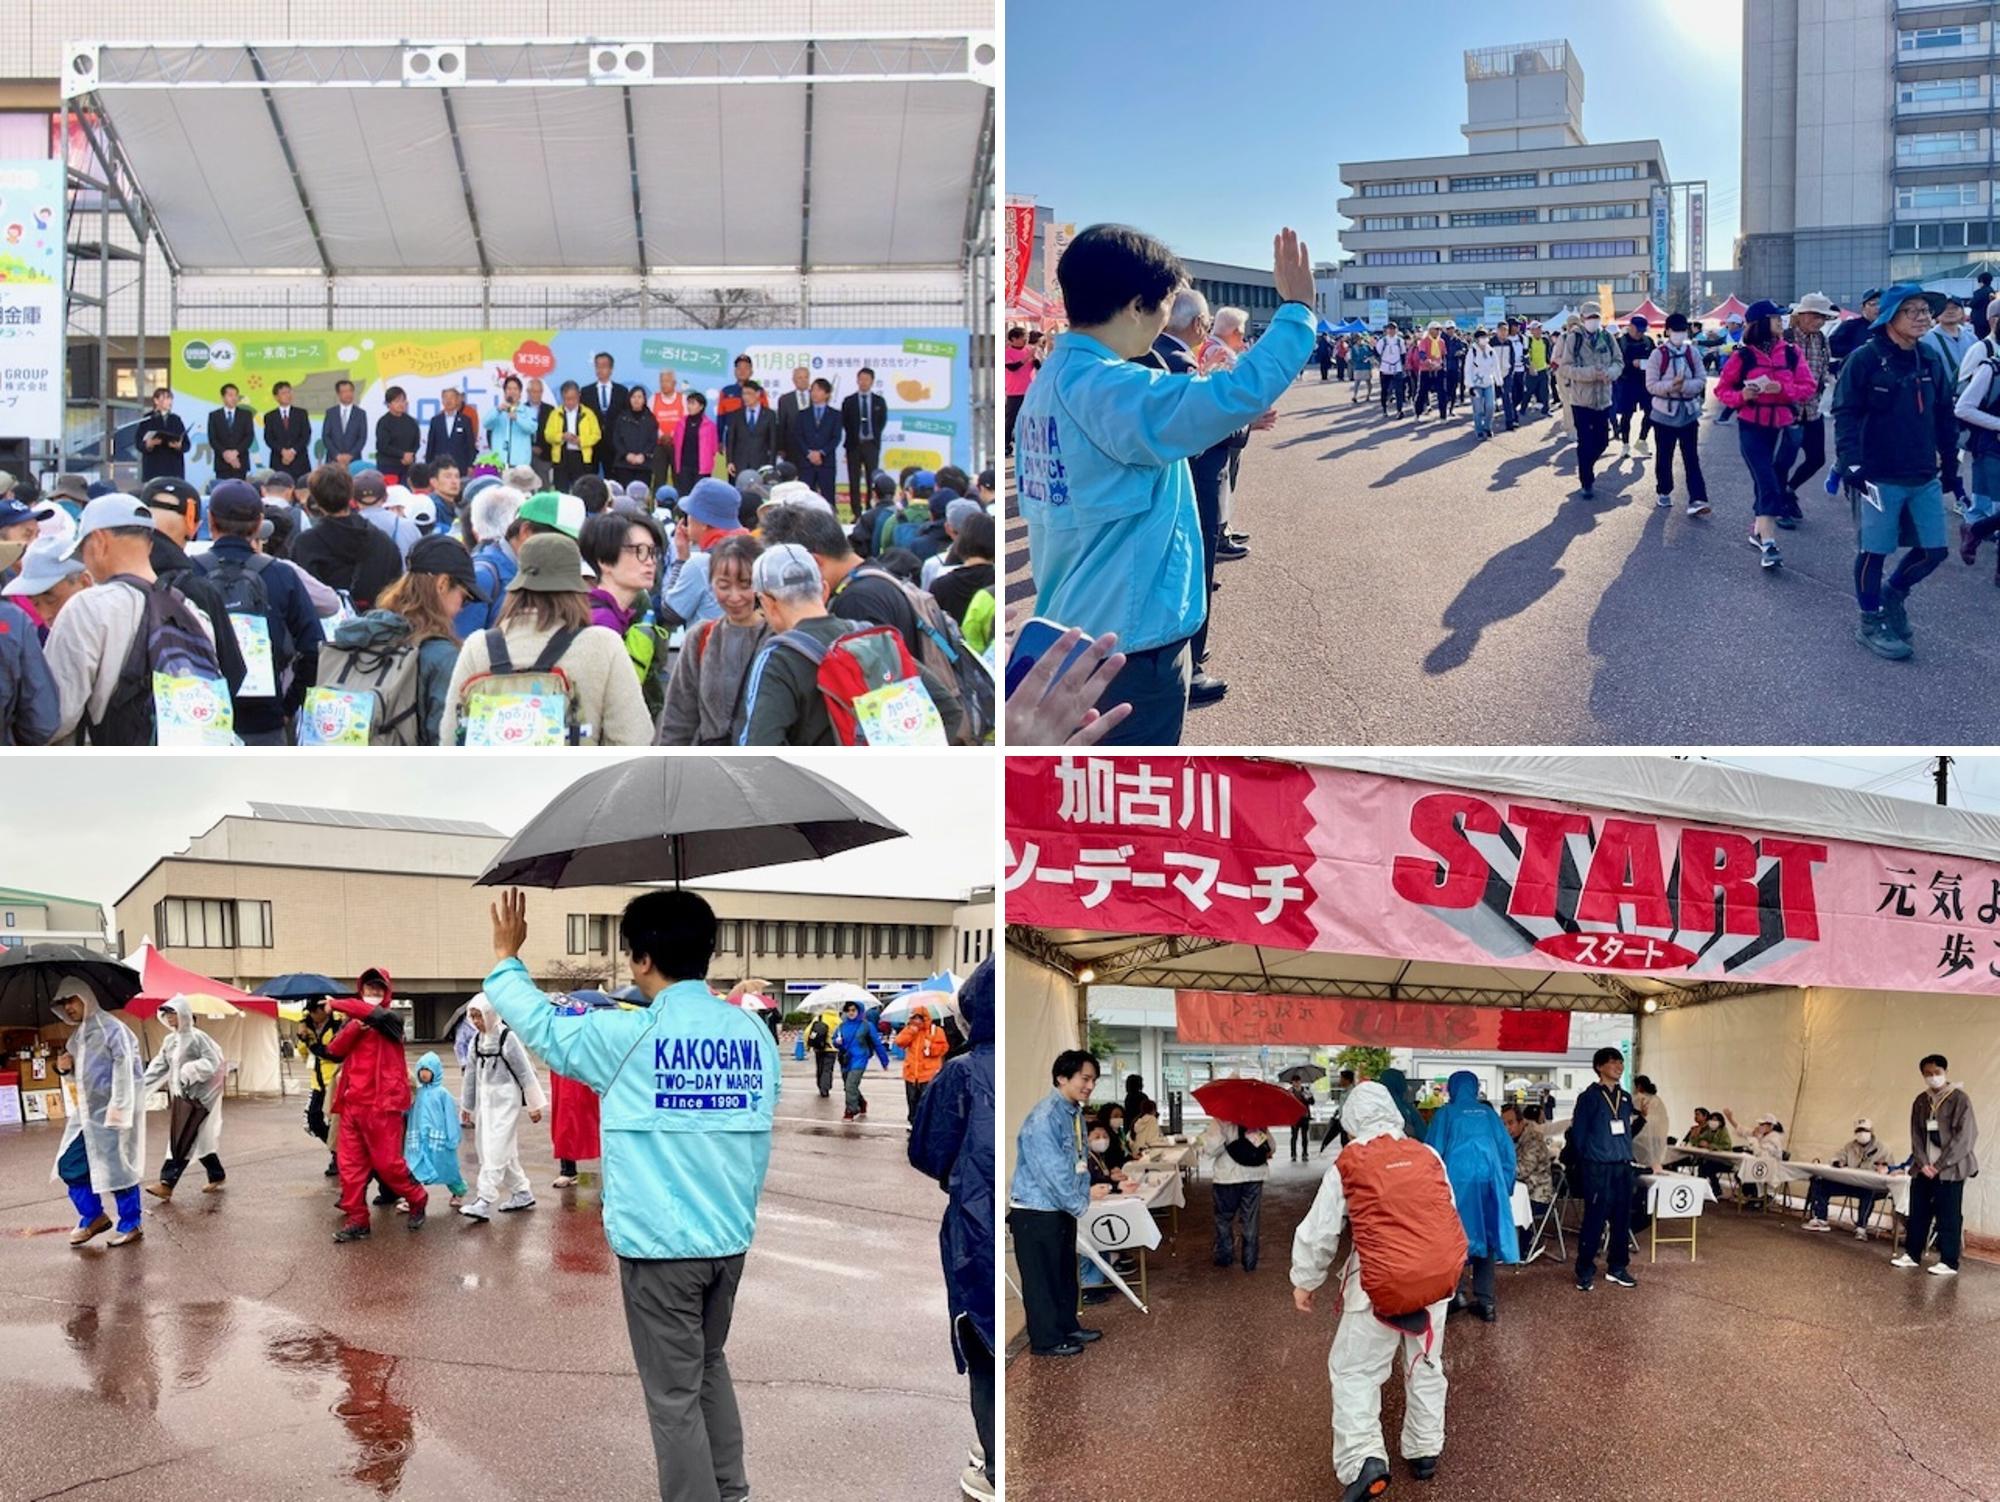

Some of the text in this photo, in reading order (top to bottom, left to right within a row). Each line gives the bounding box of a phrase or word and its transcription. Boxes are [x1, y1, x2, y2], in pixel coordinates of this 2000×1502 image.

[0, 305, 42, 325] 金庫
[661, 346, 722, 367] 西北コース
[754, 352, 811, 371] 11月8日
[5, 369, 48, 380] GROUP
[5, 382, 48, 392] 株式会社
[1055, 756, 1231, 839] 加古川
[1392, 793, 1828, 942] START
[1876, 867, 2000, 924] 元気よ
[1575, 935, 1664, 968] スタート
[655, 1038, 762, 1071] KAKOGAWA
[656, 1074, 763, 1090] TWO-DAY MARCH
[662, 1095, 740, 1108] since 1990
